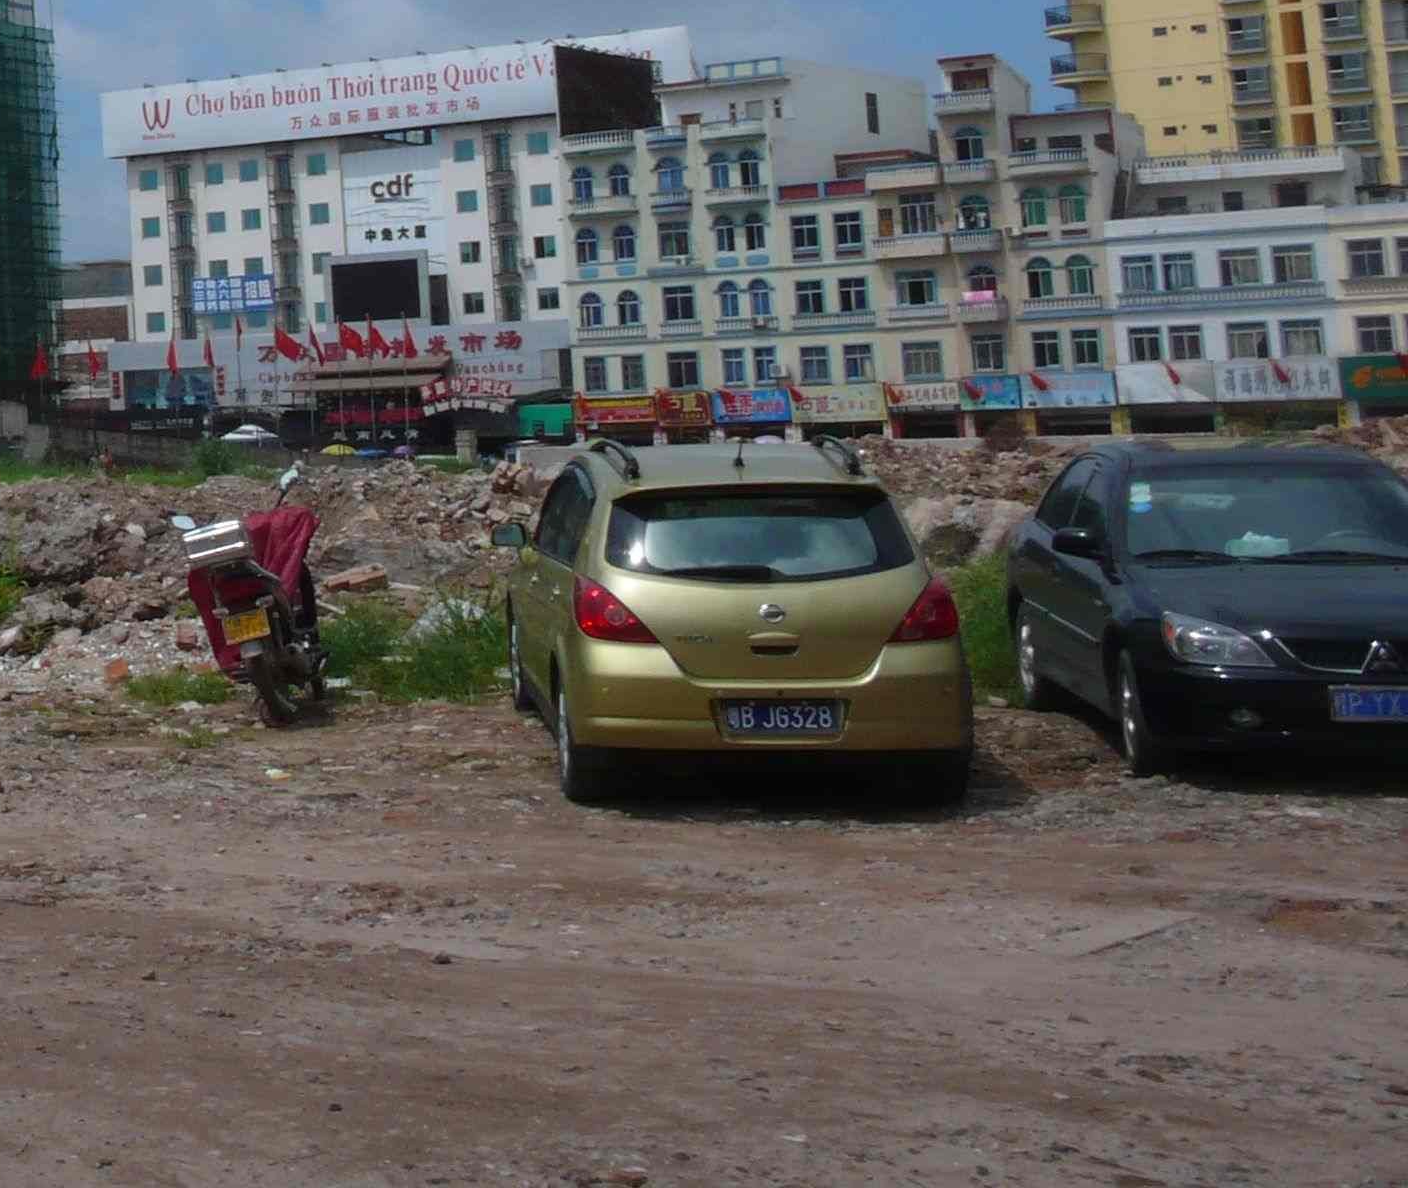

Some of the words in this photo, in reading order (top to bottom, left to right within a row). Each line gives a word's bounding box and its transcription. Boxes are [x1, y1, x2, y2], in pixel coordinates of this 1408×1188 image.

[380, 71, 437, 95] trang
[370, 173, 414, 198] cdf
[763, 705, 832, 729] JG328
